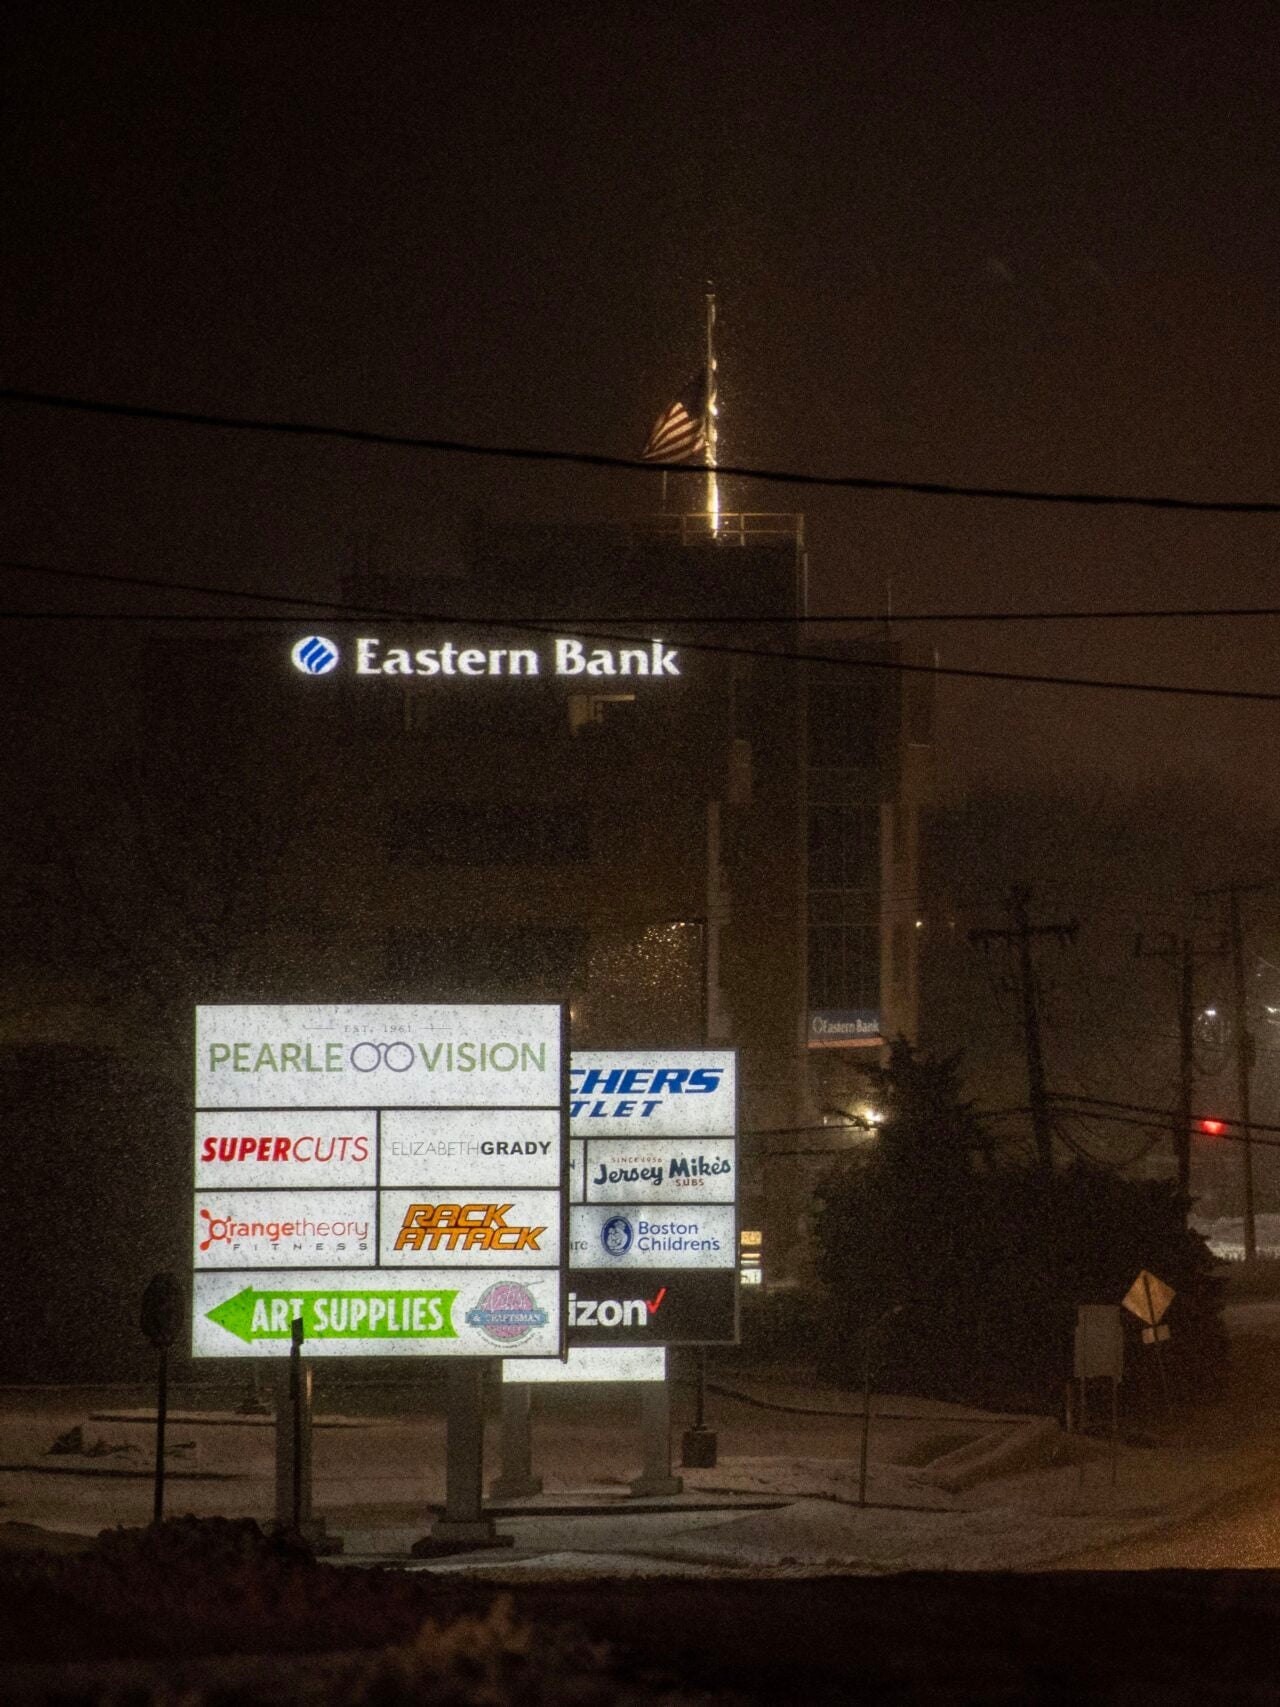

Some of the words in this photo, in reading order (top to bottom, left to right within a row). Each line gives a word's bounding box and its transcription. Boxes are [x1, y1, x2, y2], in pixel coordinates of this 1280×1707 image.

[355, 637, 541, 675] Eastern
[554, 637, 682, 675] Bank
[344, 1025, 373, 1033] EST.
[209, 1043, 344, 1073] PEARLE
[418, 1042, 546, 1073] VISION
[201, 1136, 369, 1162] SUPERCUTS
[593, 1164, 664, 1186] Jersey
[668, 1155, 731, 1179] Mike's
[675, 1178, 705, 1187] SUBS
[401, 1204, 516, 1228] RACK
[638, 1221, 698, 1235] Boston
[233, 1243, 368, 1251] FITNESS
[393, 1227, 548, 1251] ATTACK
[637, 1237, 720, 1251] Children's
[251, 1298, 304, 1332] ART
[313, 1297, 444, 1332] SUPPLIES
[568, 1293, 647, 1326] izon
